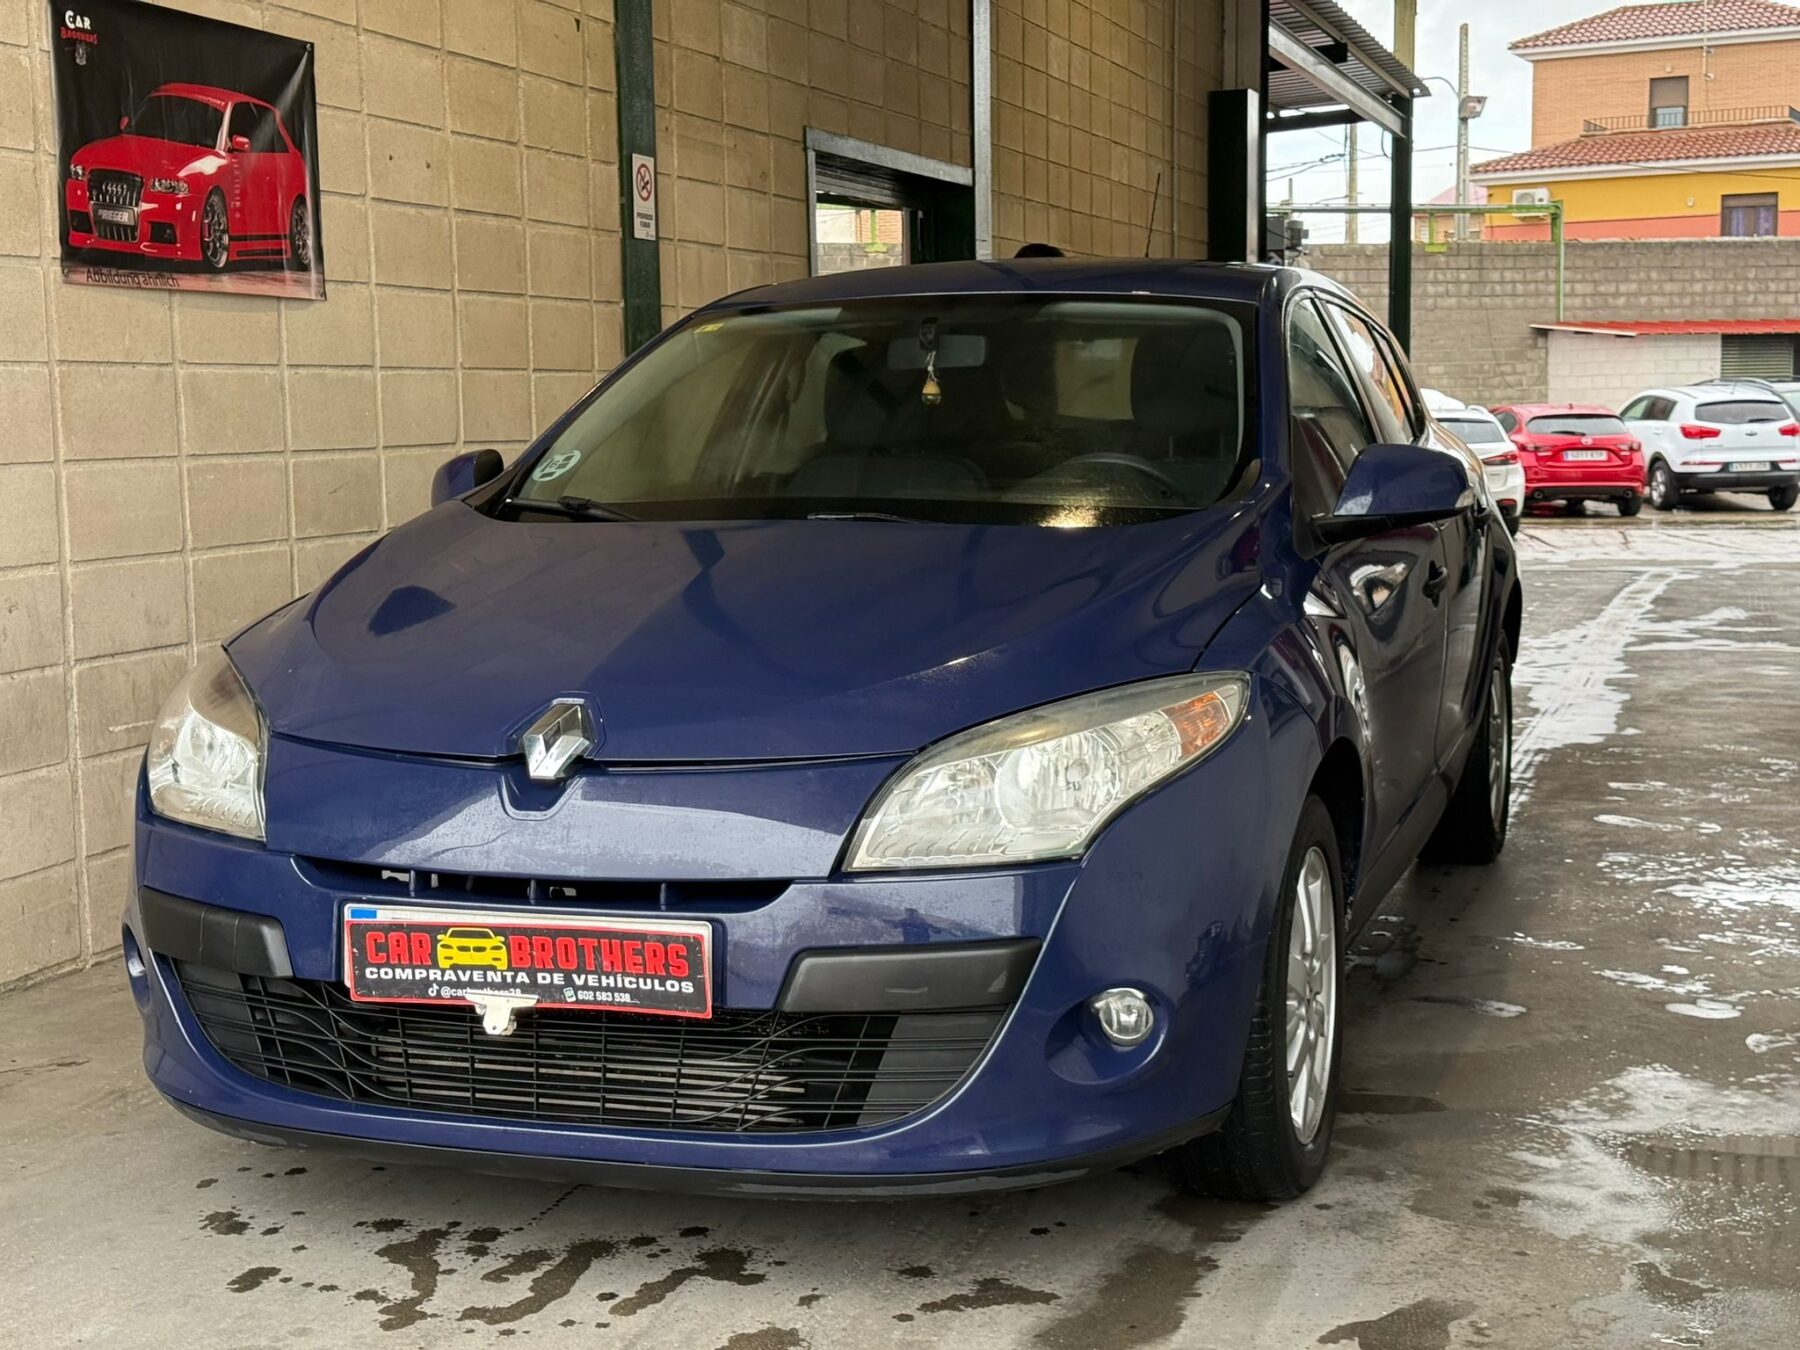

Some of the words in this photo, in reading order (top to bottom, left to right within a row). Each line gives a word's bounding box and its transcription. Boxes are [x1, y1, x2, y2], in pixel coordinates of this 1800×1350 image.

[86, 266, 142, 289] Abbildung
[365, 931, 432, 966] CAR
[508, 935, 689, 978] BROTHERS
[365, 967, 531, 984] COMPRAVENTA
[537, 973, 565, 985] DE
[572, 973, 695, 993] VEHÍCULOS
[577, 990, 594, 1000] 602
[596, 991, 613, 1001] 583
